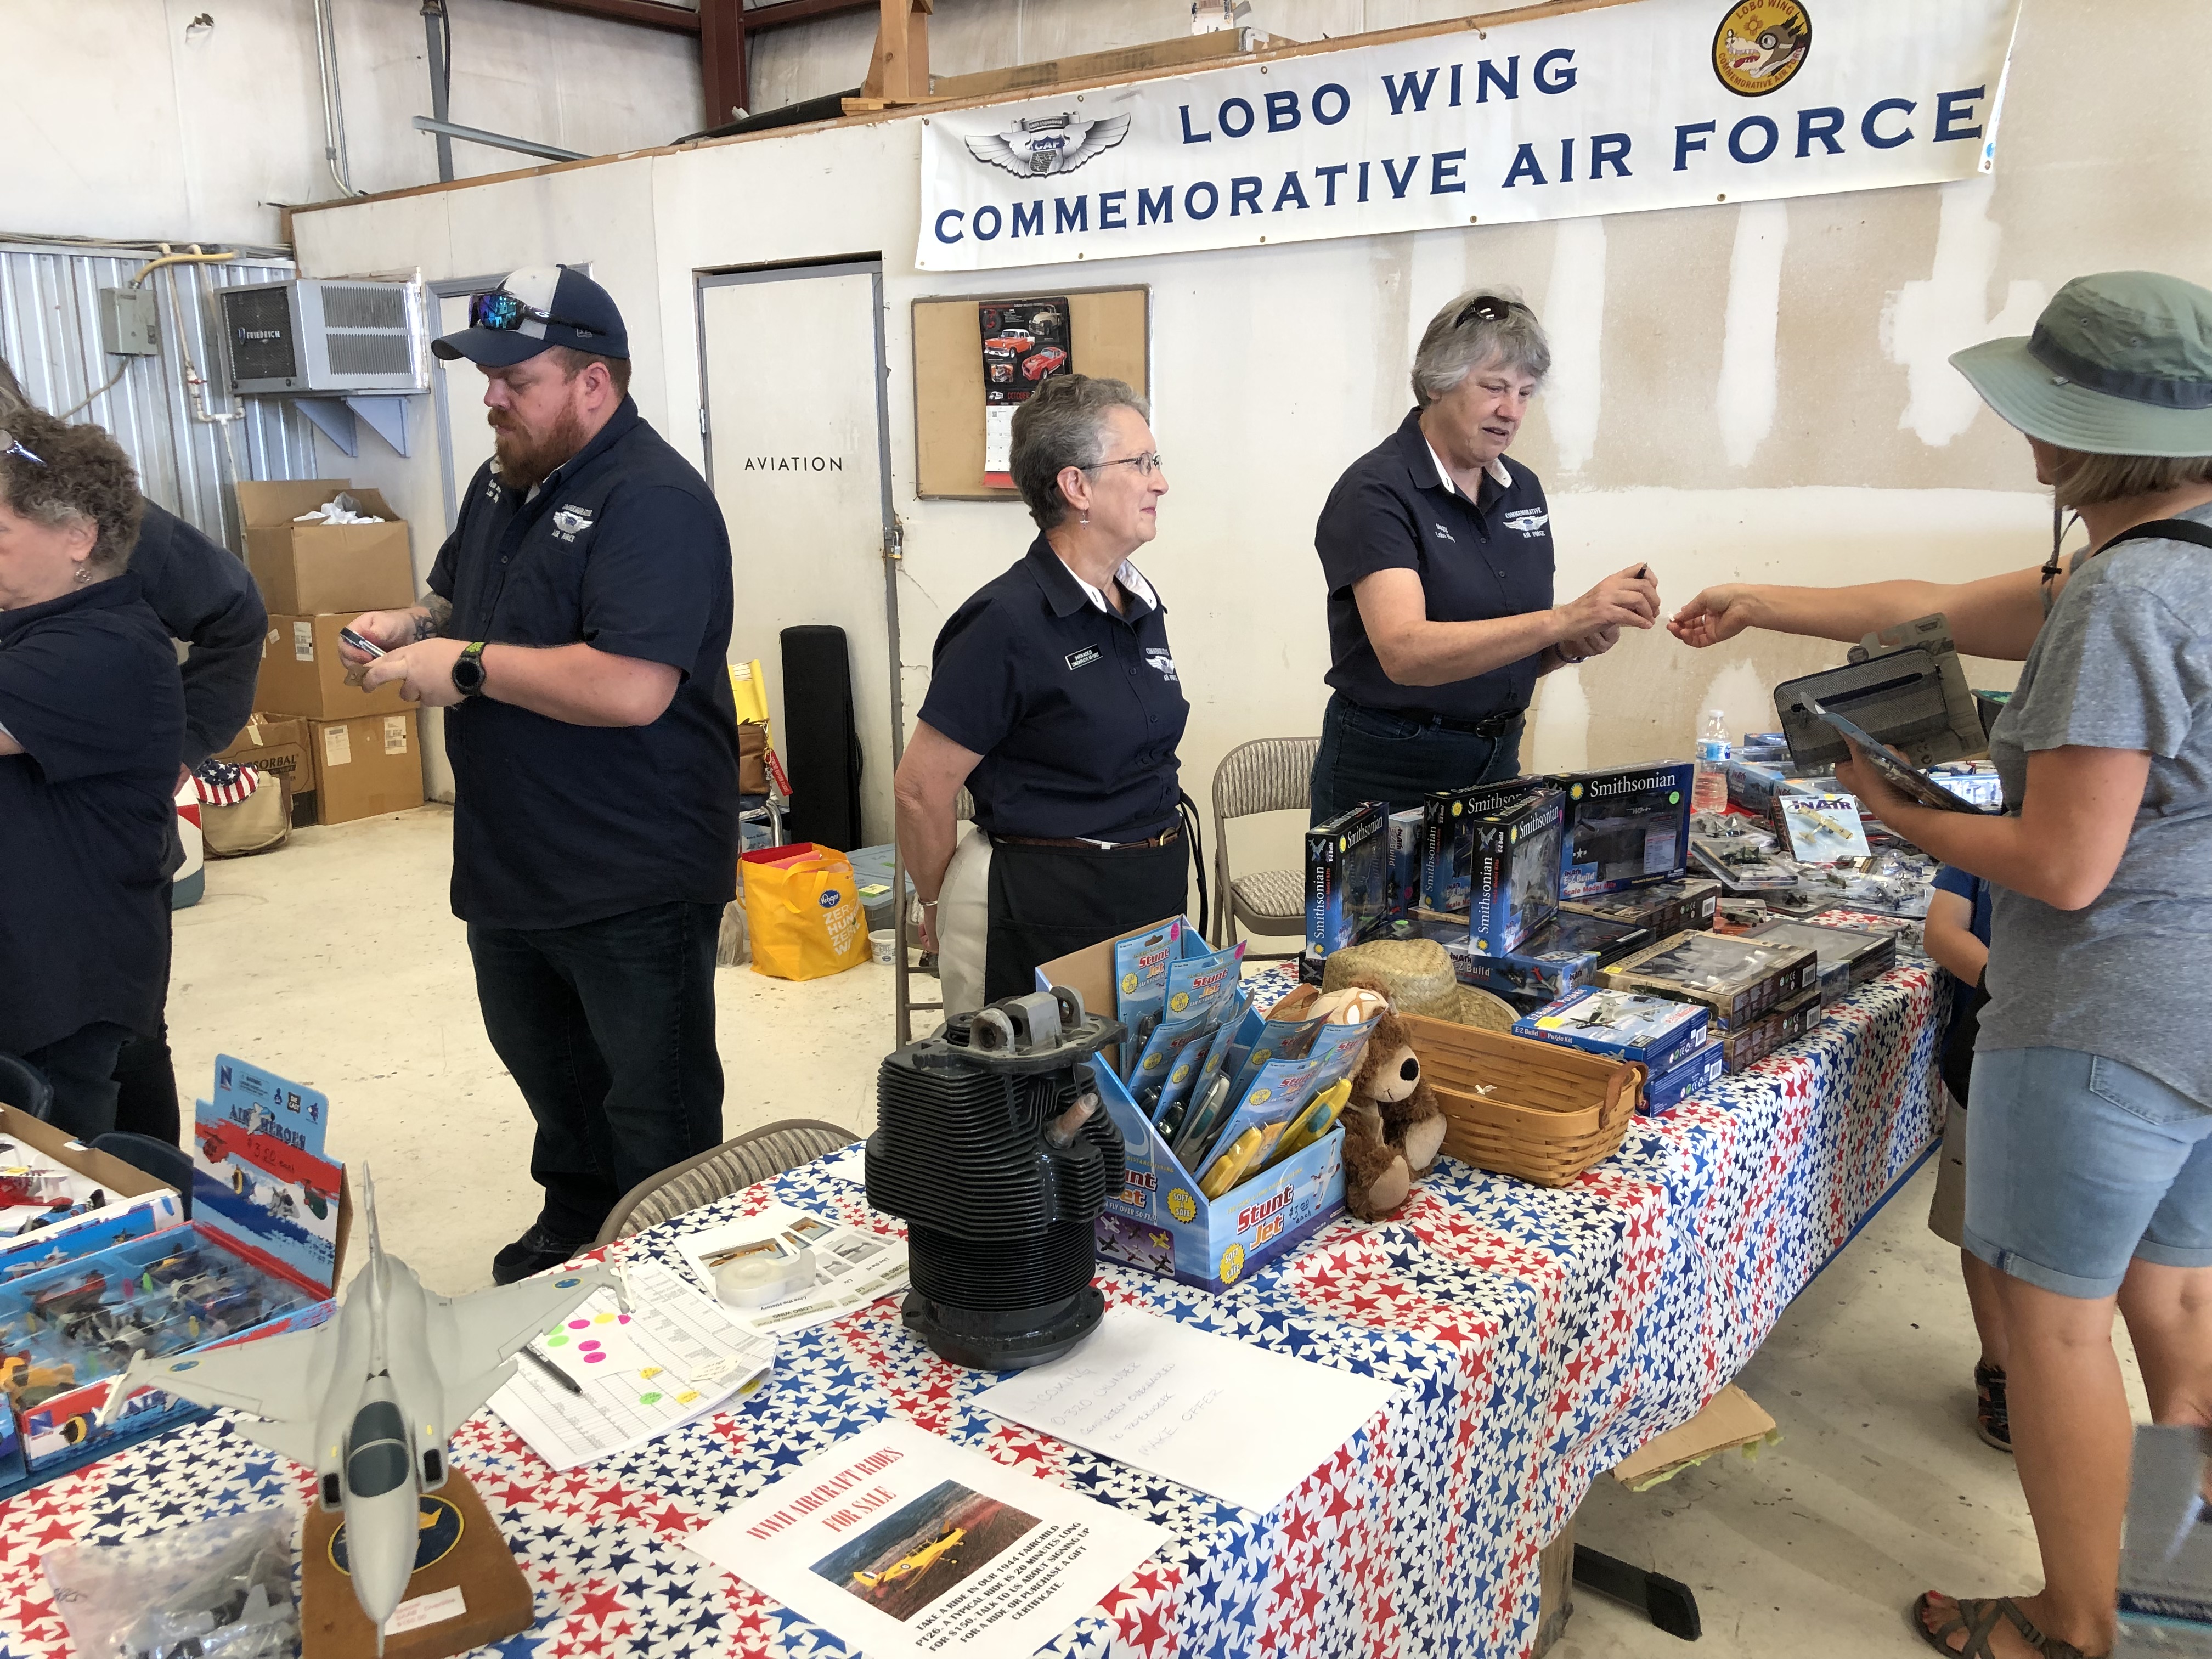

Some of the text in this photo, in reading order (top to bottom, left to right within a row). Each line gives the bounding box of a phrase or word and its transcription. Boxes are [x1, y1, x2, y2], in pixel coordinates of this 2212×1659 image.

[1736, 0, 1794, 19] LOBO WING
[1719, 53, 1773, 89] COMMEMORATIVE
[1775, 69, 1788, 83] AIR
[1178, 48, 1578, 145] LOBO WING
[1034, 142, 1060, 150] CAF
[934, 84, 1987, 244] COMMEMORATIVE AIR FORCE
[247, 331, 280, 339] FRIEDRICH
[744, 456, 842, 471] AVIATION
[1505, 507, 1542, 518] COMMEMORATIVE
[1590, 772, 1675, 798] Smithsonian
[1468, 788, 1527, 814] Smithso
[1347, 815, 1383, 849] Smithsonian
[1520, 805, 1559, 839] Smithsonian
[1426, 826, 1436, 892] Smithsonian
[1564, 872, 1595, 884] E-Z Build
[821, 894, 839, 905] Kroger
[1478, 857, 1492, 934] Smithsonian
[1583, 885, 1602, 894] Model
[823, 899, 856, 925] ZERO
[1313, 867, 1324, 939] Smithsonian
[827, 905, 860, 935] HUNG
[1138, 947, 1170, 969] Stunt
[1146, 962, 1165, 978] Jet
[1192, 968, 1229, 989] Stunt
[1466, 965, 1491, 978] Build
[1199, 983, 1221, 998] Jet
[1526, 1011, 1541, 1021] E-Z
[1541, 1005, 1555, 1015] Build
[1524, 1028, 1538, 1037] Build
[1547, 1032, 1564, 1042] Puzzle
[289, 1102, 300, 1110] CAST
[229, 1104, 306, 1151] AIR HEROES
[1108, 1188, 1146, 1208] et
[1173, 1193, 1189, 1203] SOFT
[1110, 1202, 1119, 1210] FLY
[1120, 1206, 1134, 1216] OVER
[1136, 1210, 1143, 1218] 50
[1175, 1208, 1191, 1217] SAFE
[1237, 1183, 1294, 1235] Stunt
[1296, 1209, 1312, 1224] each
[1250, 1213, 1285, 1252] Jet
[1225, 1247, 1239, 1263] SOFT
[1226, 1263, 1240, 1280] SAFE
[760, 1301, 782, 1311] History
[772, 1305, 813, 1319] LOBO WING
[1182, 1389, 1224, 1422] OFFER
[746, 1446, 904, 1541] WWII AIRCRAFT RIDES
[822, 1486, 897, 1532] FOR SALE
[915, 1612, 941, 1630] TAKE
[946, 1593, 969, 1609] RIDE
[967, 1585, 980, 1594] IN
[978, 1573, 998, 1587] OUR
[997, 1556, 1020, 1573] 1944
[1018, 1525, 1059, 1556] FAIRCHILD
[915, 1628, 944, 1647] PT26.
[949, 1596, 986, 1620] TYPICAL
[983, 1581, 1007, 1597] RIDE
[1003, 1574, 1015, 1582] IS
[1014, 1565, 1028, 1575] 20
[1025, 1538, 1060, 1565] MINUTES
[1058, 1522, 1081, 1538] LONG
[929, 1527, 1090, 1652] FOR $150. TALK TO US ABOUT SIGNING UP
[960, 1628, 981, 1643] FOR
[986, 1607, 1010, 1623] RIDE
[1007, 1598, 1023, 1609] OR
[1020, 1565, 1064, 1599] PURCHASE
[1068, 1545, 1087, 1560] GIFT
[1012, 1582, 1065, 1620] CERTIFICATE.
